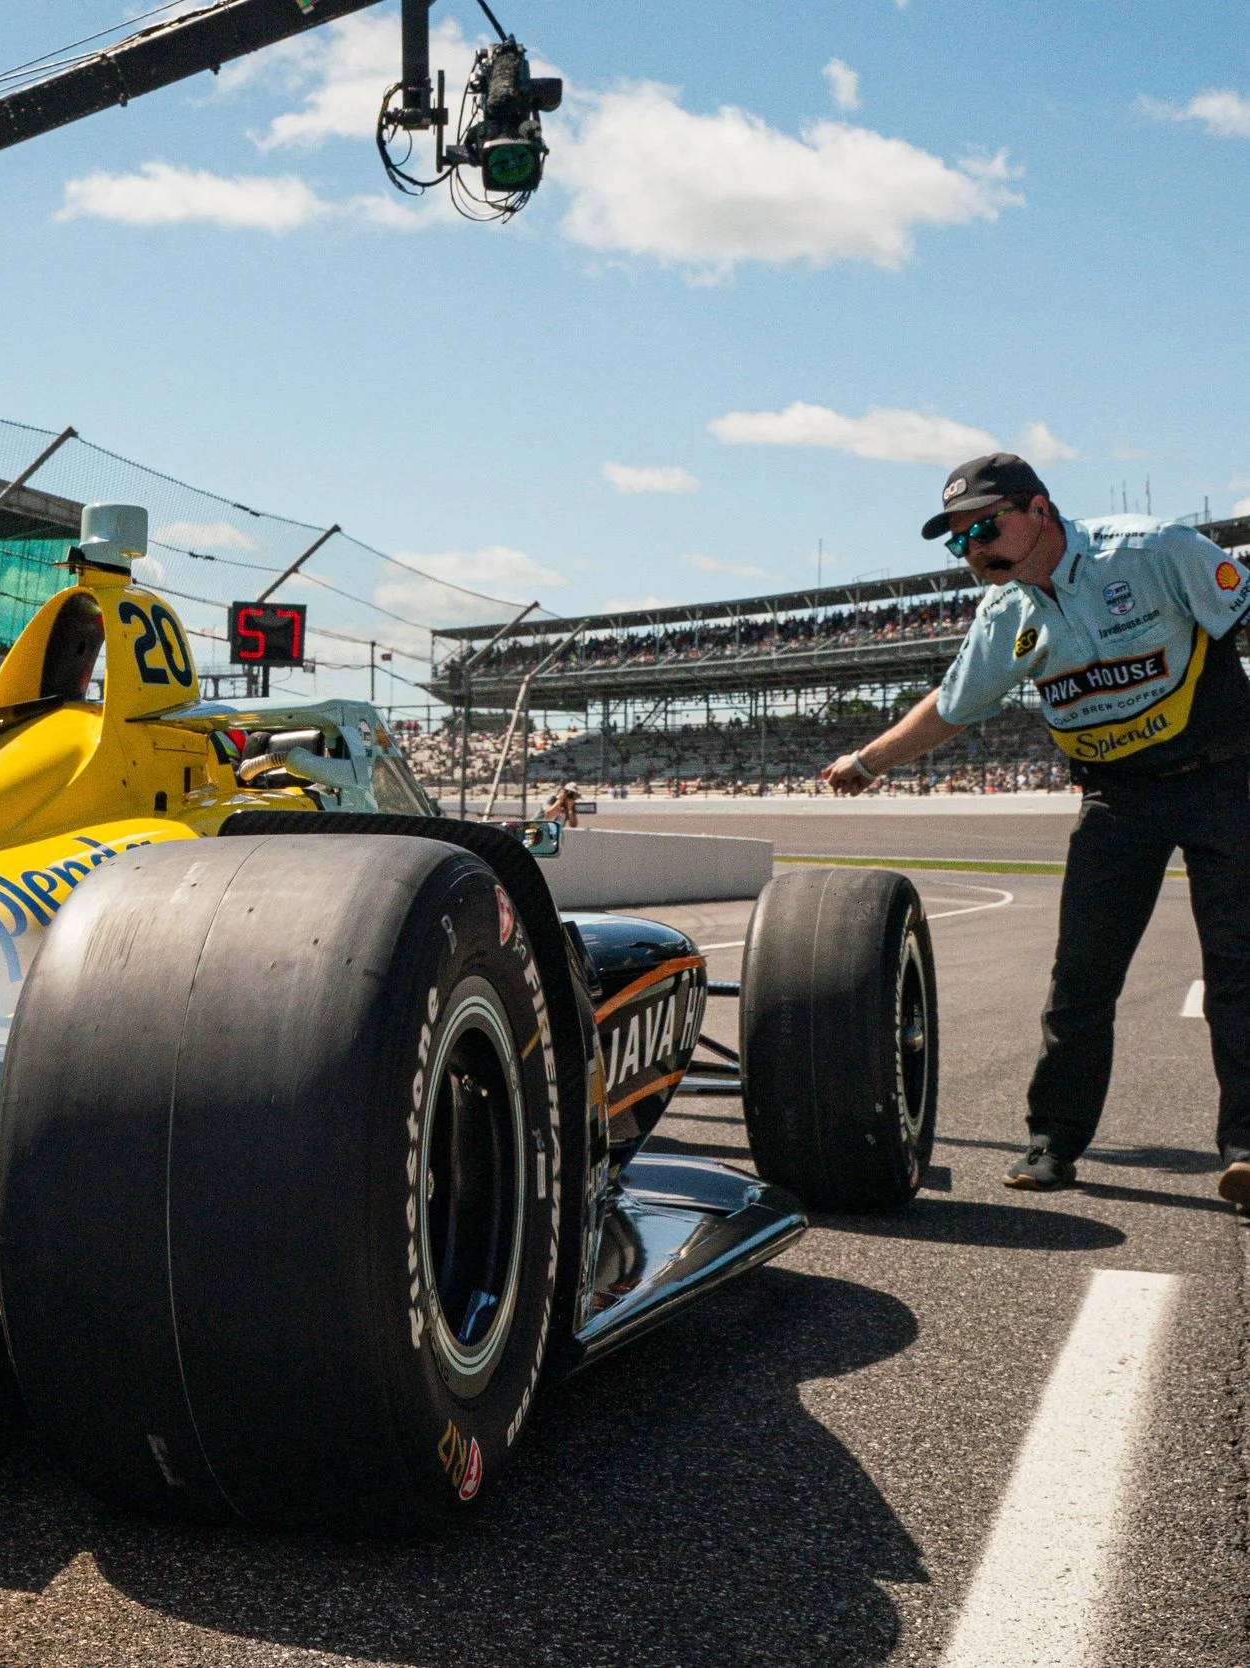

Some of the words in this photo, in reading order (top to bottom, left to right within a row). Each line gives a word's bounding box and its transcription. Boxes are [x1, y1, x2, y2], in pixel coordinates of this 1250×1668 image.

[118, 601, 192, 687] 20
[238, 608, 301, 659] 57
[1082, 703, 1113, 715] BREW
[1117, 687, 1166, 709] COFFEE
[1086, 658, 1158, 688] HOUSE
[1074, 712, 1169, 760] Splenda
[606, 995, 676, 1092] JAVA
[523, 959, 561, 1281] FIREHAWK
[405, 986, 440, 1349] Firestone
[530, 1296, 551, 1393] INDY
[507, 1386, 531, 1447] 500
